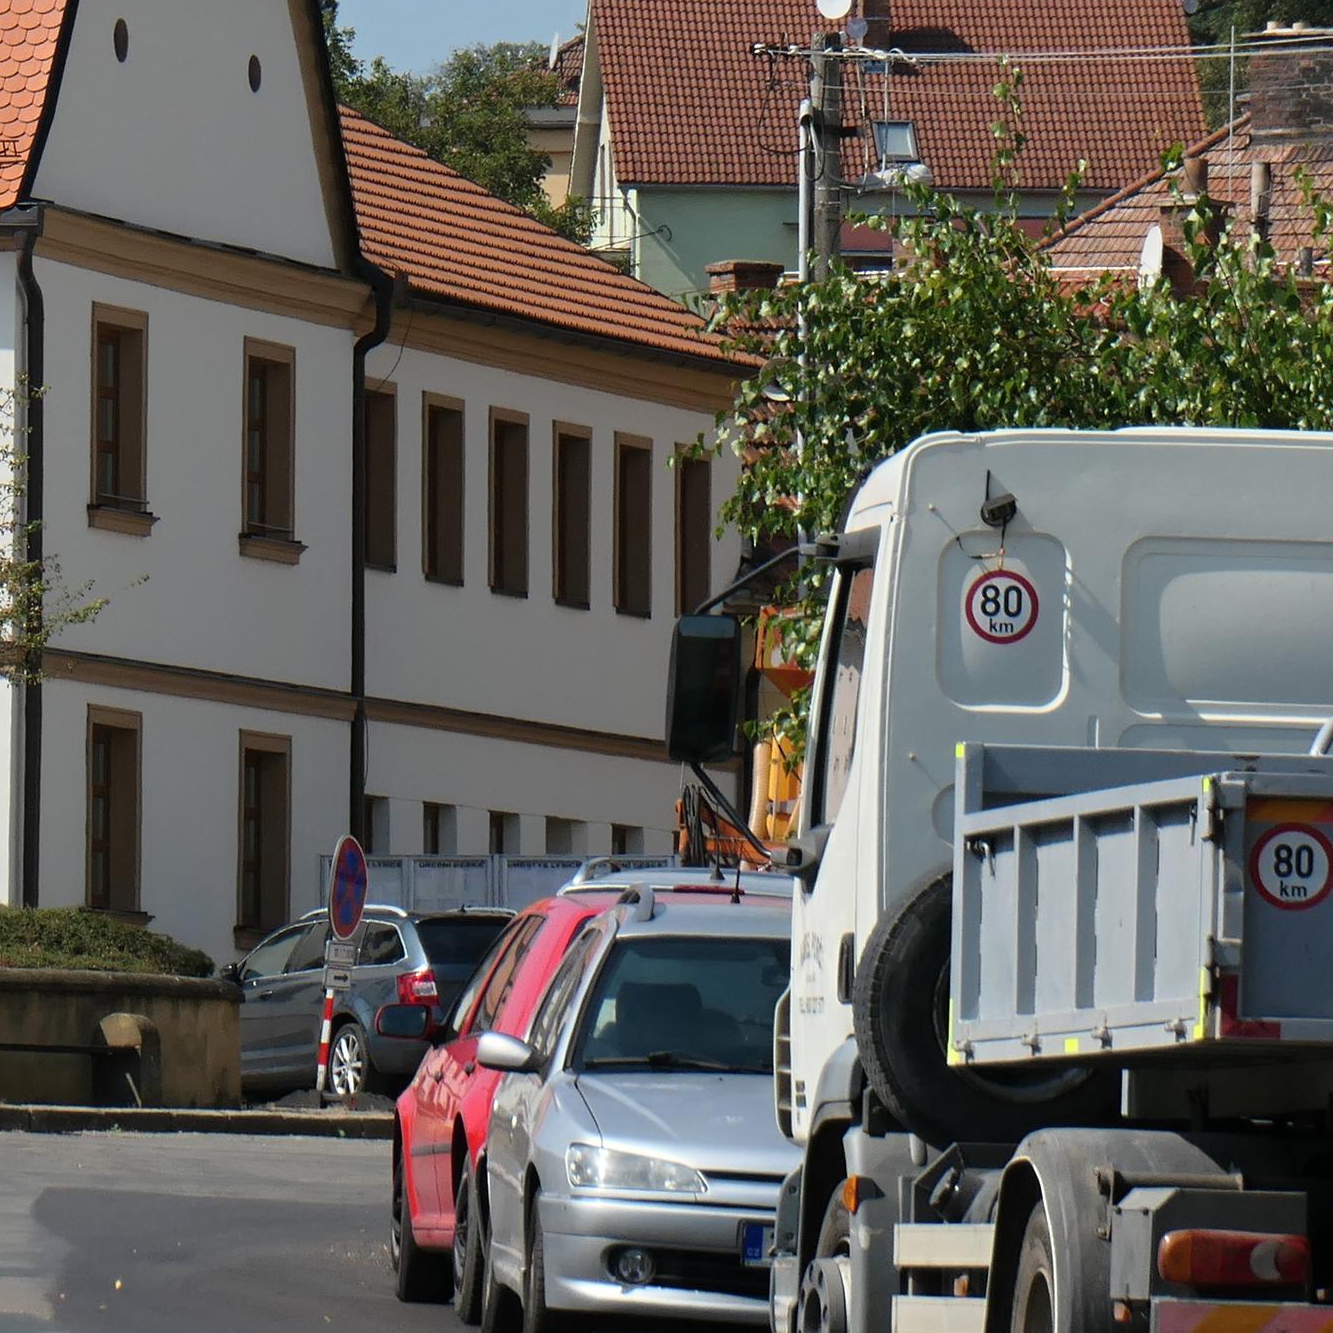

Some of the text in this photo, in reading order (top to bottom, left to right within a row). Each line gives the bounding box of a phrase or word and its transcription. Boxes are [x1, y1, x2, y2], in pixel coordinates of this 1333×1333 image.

[980, 584, 1023, 618] 80
[989, 617, 1014, 633] km
[1274, 843, 1314, 879] 80
[1279, 879, 1308, 898] km
